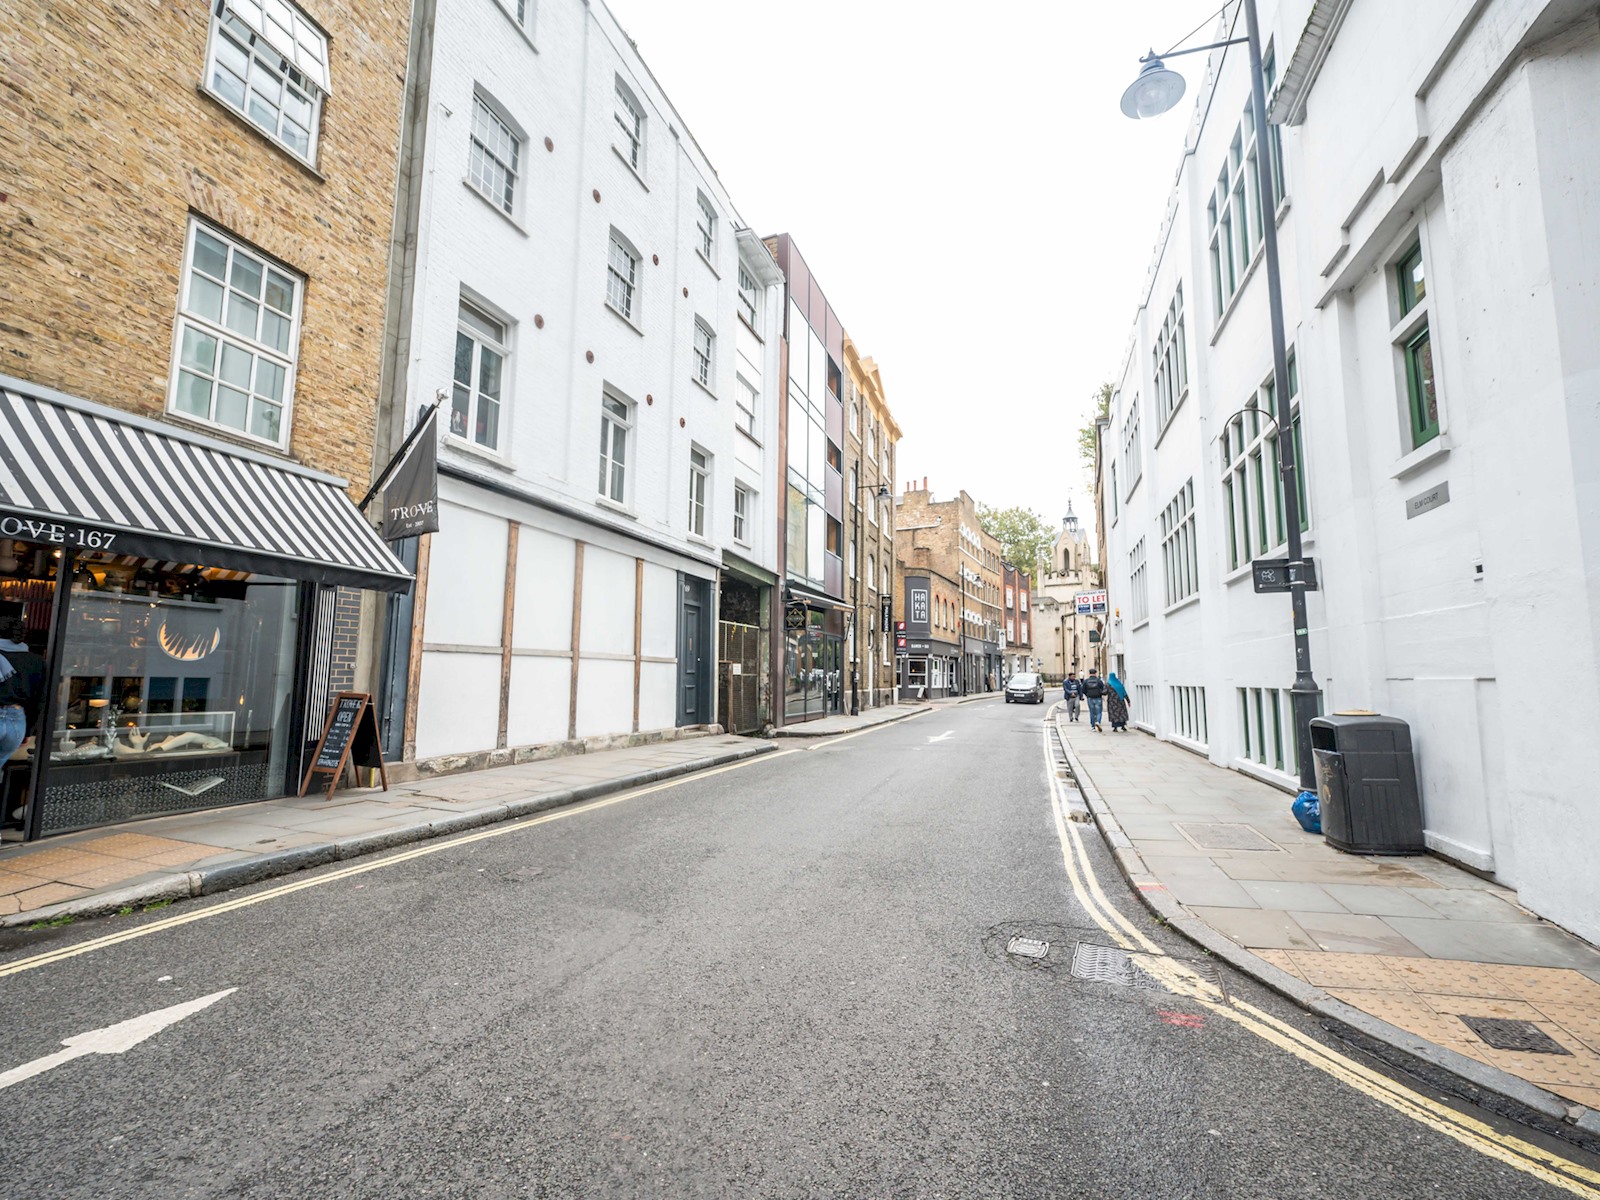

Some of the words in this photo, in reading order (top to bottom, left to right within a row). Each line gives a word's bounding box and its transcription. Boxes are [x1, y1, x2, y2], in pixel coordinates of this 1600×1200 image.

[1414, 500, 1423, 510] ELM
[1423, 492, 1438, 504] COURT
[390, 500, 433, 520] TROVE
[914, 593, 926, 601] HA
[914, 602, 926, 610] KA
[914, 611, 926, 619] TA
[336, 711, 354, 722] OPEN
